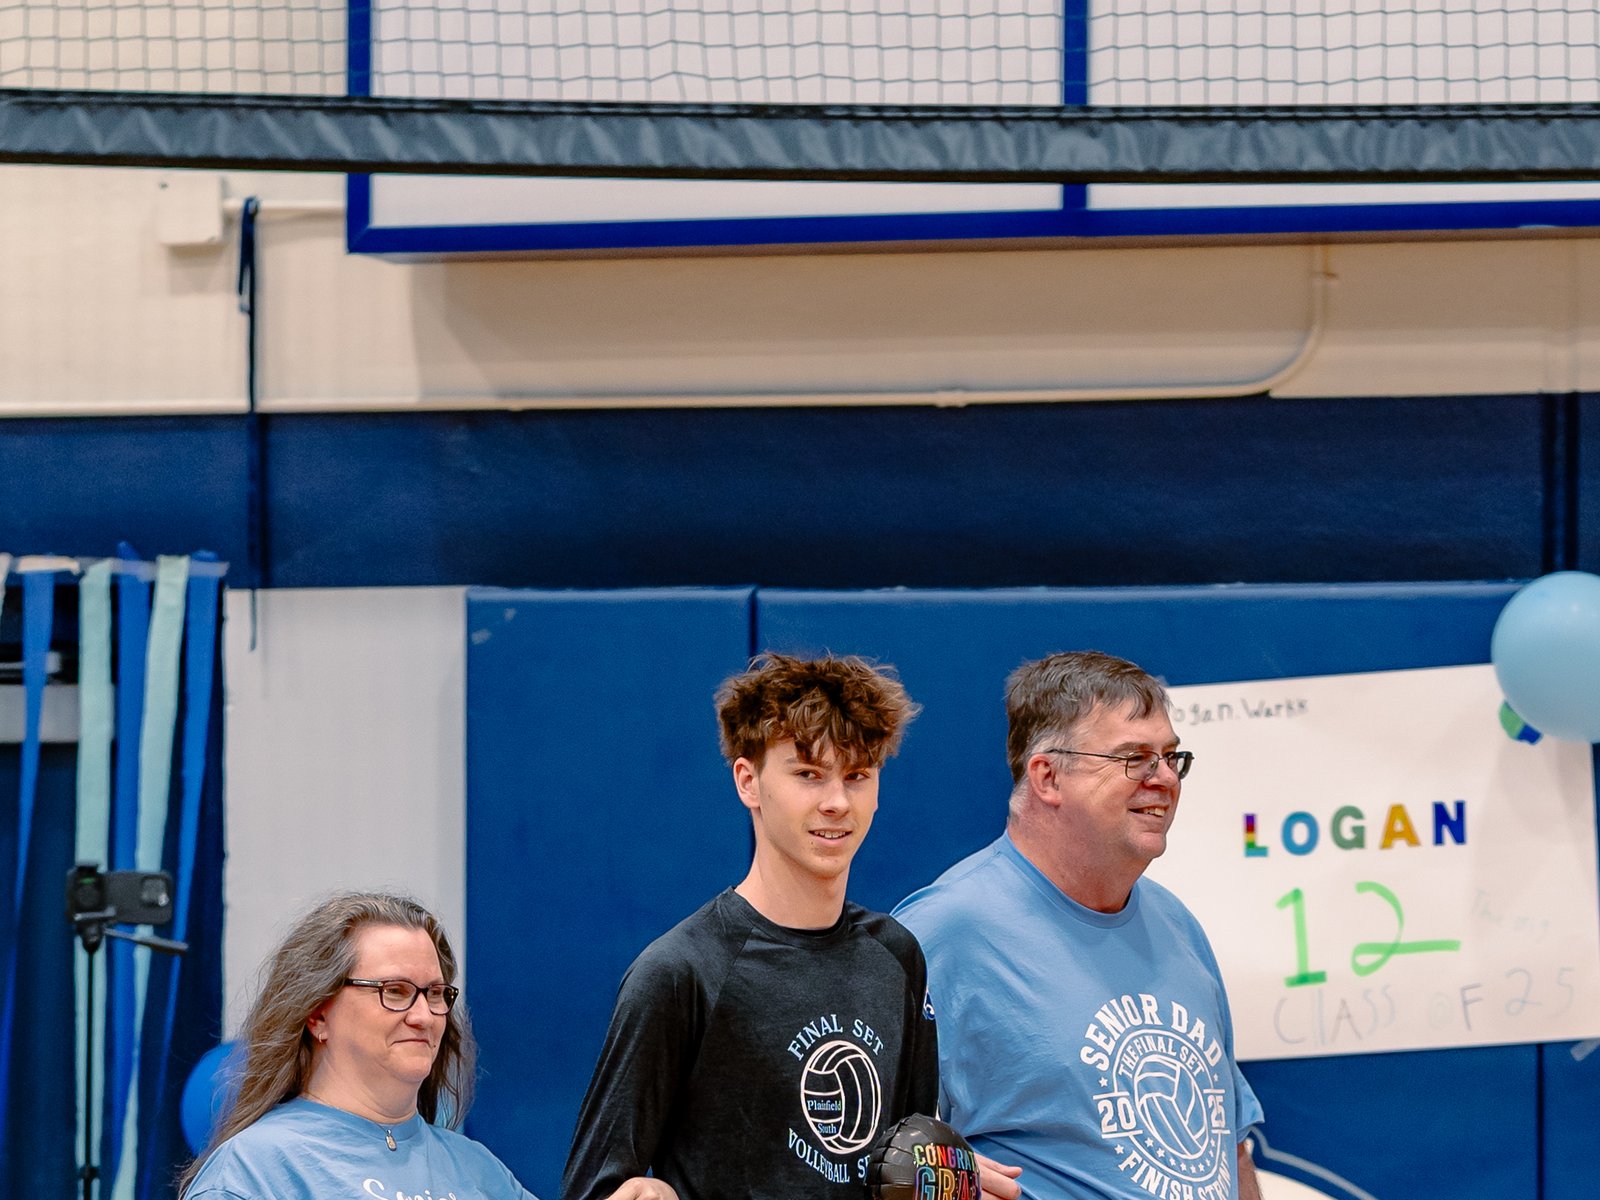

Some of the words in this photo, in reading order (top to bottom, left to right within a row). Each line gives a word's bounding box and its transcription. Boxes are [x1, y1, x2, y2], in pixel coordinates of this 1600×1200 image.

[1172, 703, 1233, 725] ogan
[1243, 800, 1467, 858] LOGAN
[1276, 881, 1461, 988] 12
[787, 1013, 843, 1061] FINAL
[852, 1018, 884, 1056] SET
[1080, 993, 1163, 1071] SENIOR
[1170, 1001, 1223, 1067] DAD
[1118, 1044, 1141, 1079] THE
[1136, 1036, 1177, 1058] FINAL
[1179, 1045, 1205, 1077] SET
[807, 1100, 842, 1111] Plainfield
[1098, 1098, 1137, 1133] 20
[817, 1122, 838, 1135] South
[787, 1128, 850, 1183] VOLLEYBALL
[913, 1143, 980, 1175] CONGRAT
